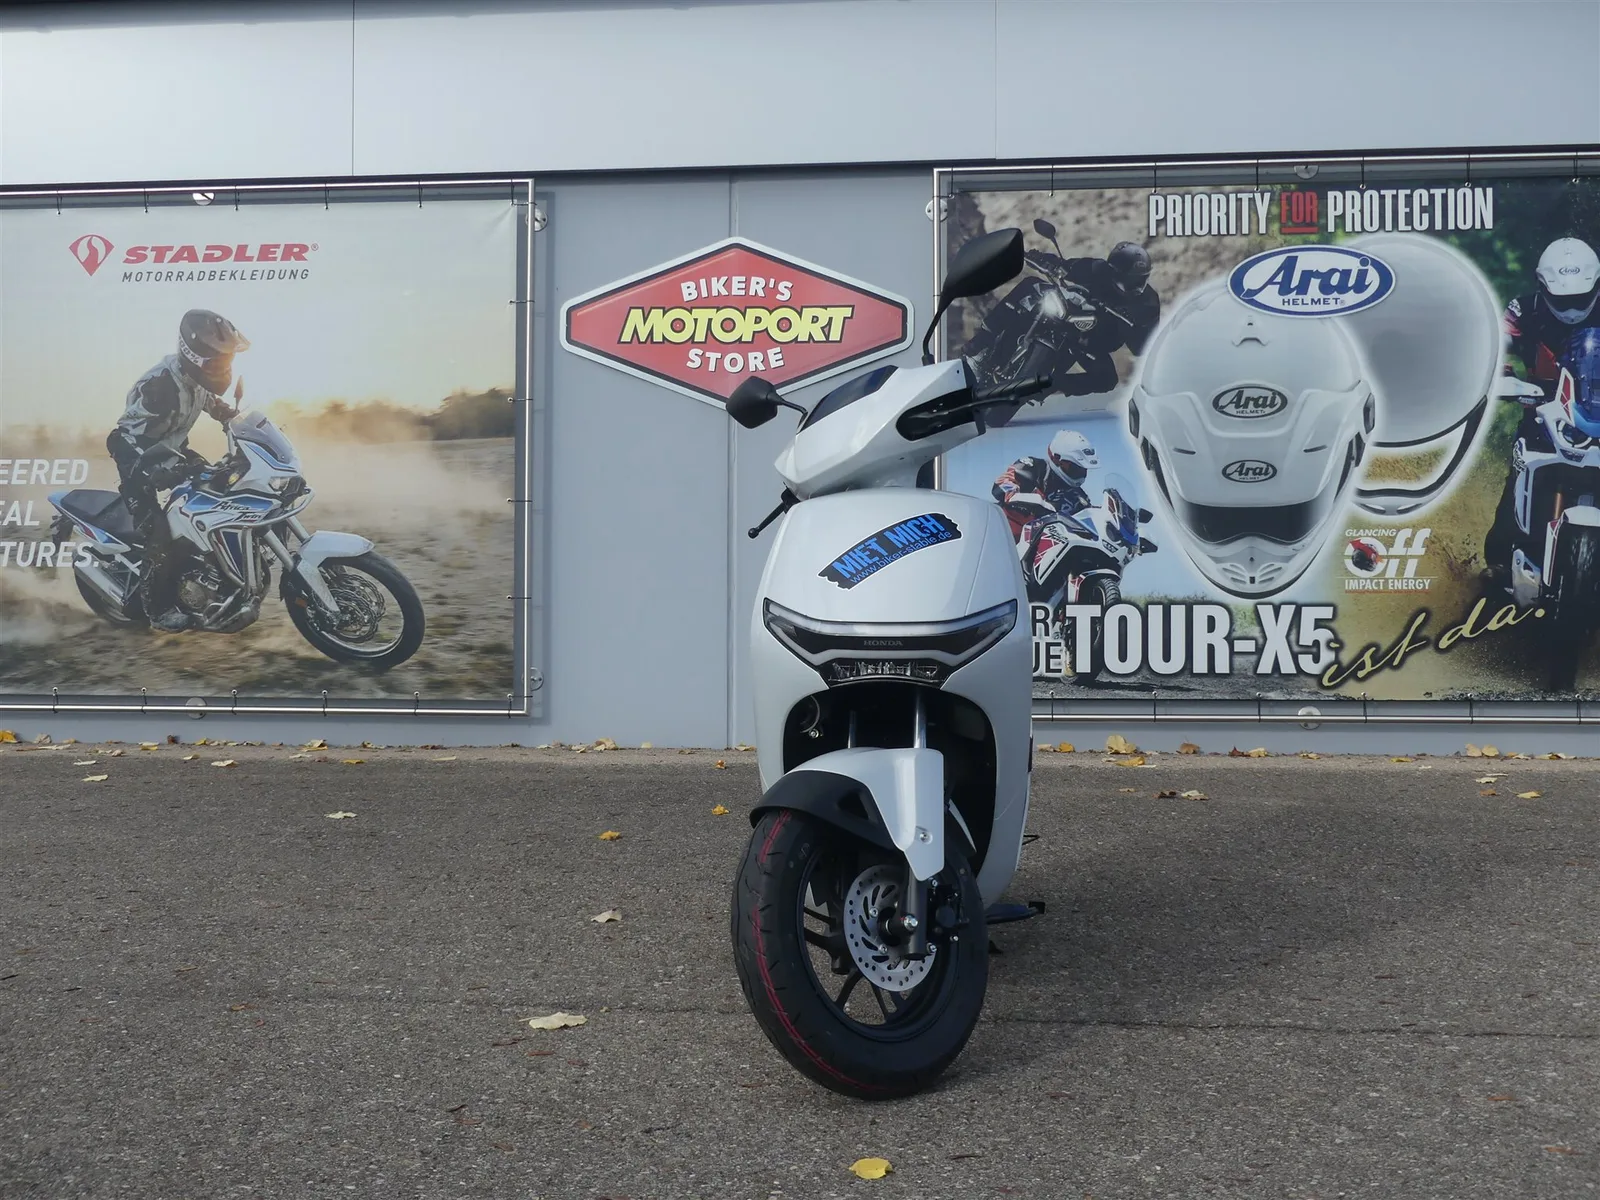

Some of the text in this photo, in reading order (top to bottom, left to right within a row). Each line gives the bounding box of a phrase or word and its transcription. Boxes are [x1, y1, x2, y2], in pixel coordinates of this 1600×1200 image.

[1149, 187, 1494, 237] PRIORITY FOR PROTECTION
[122, 269, 310, 282] MOTORRADBEKLEIDUNG
[680, 275, 793, 303] BIKER'S
[1241, 256, 1373, 299] Arai
[617, 305, 855, 345] MOTOPORT
[686, 347, 785, 373] STORE
[1219, 390, 1279, 409] Arai
[1228, 463, 1271, 476] Arai
[832, 514, 945, 579] MIET MICH
[850, 530, 952, 583] www.biker-stable.de
[1345, 579, 1431, 590] IMPACT ENERGY
[1065, 604, 1335, 675] TOUR-X5
[1321, 612, 1427, 687] ist
